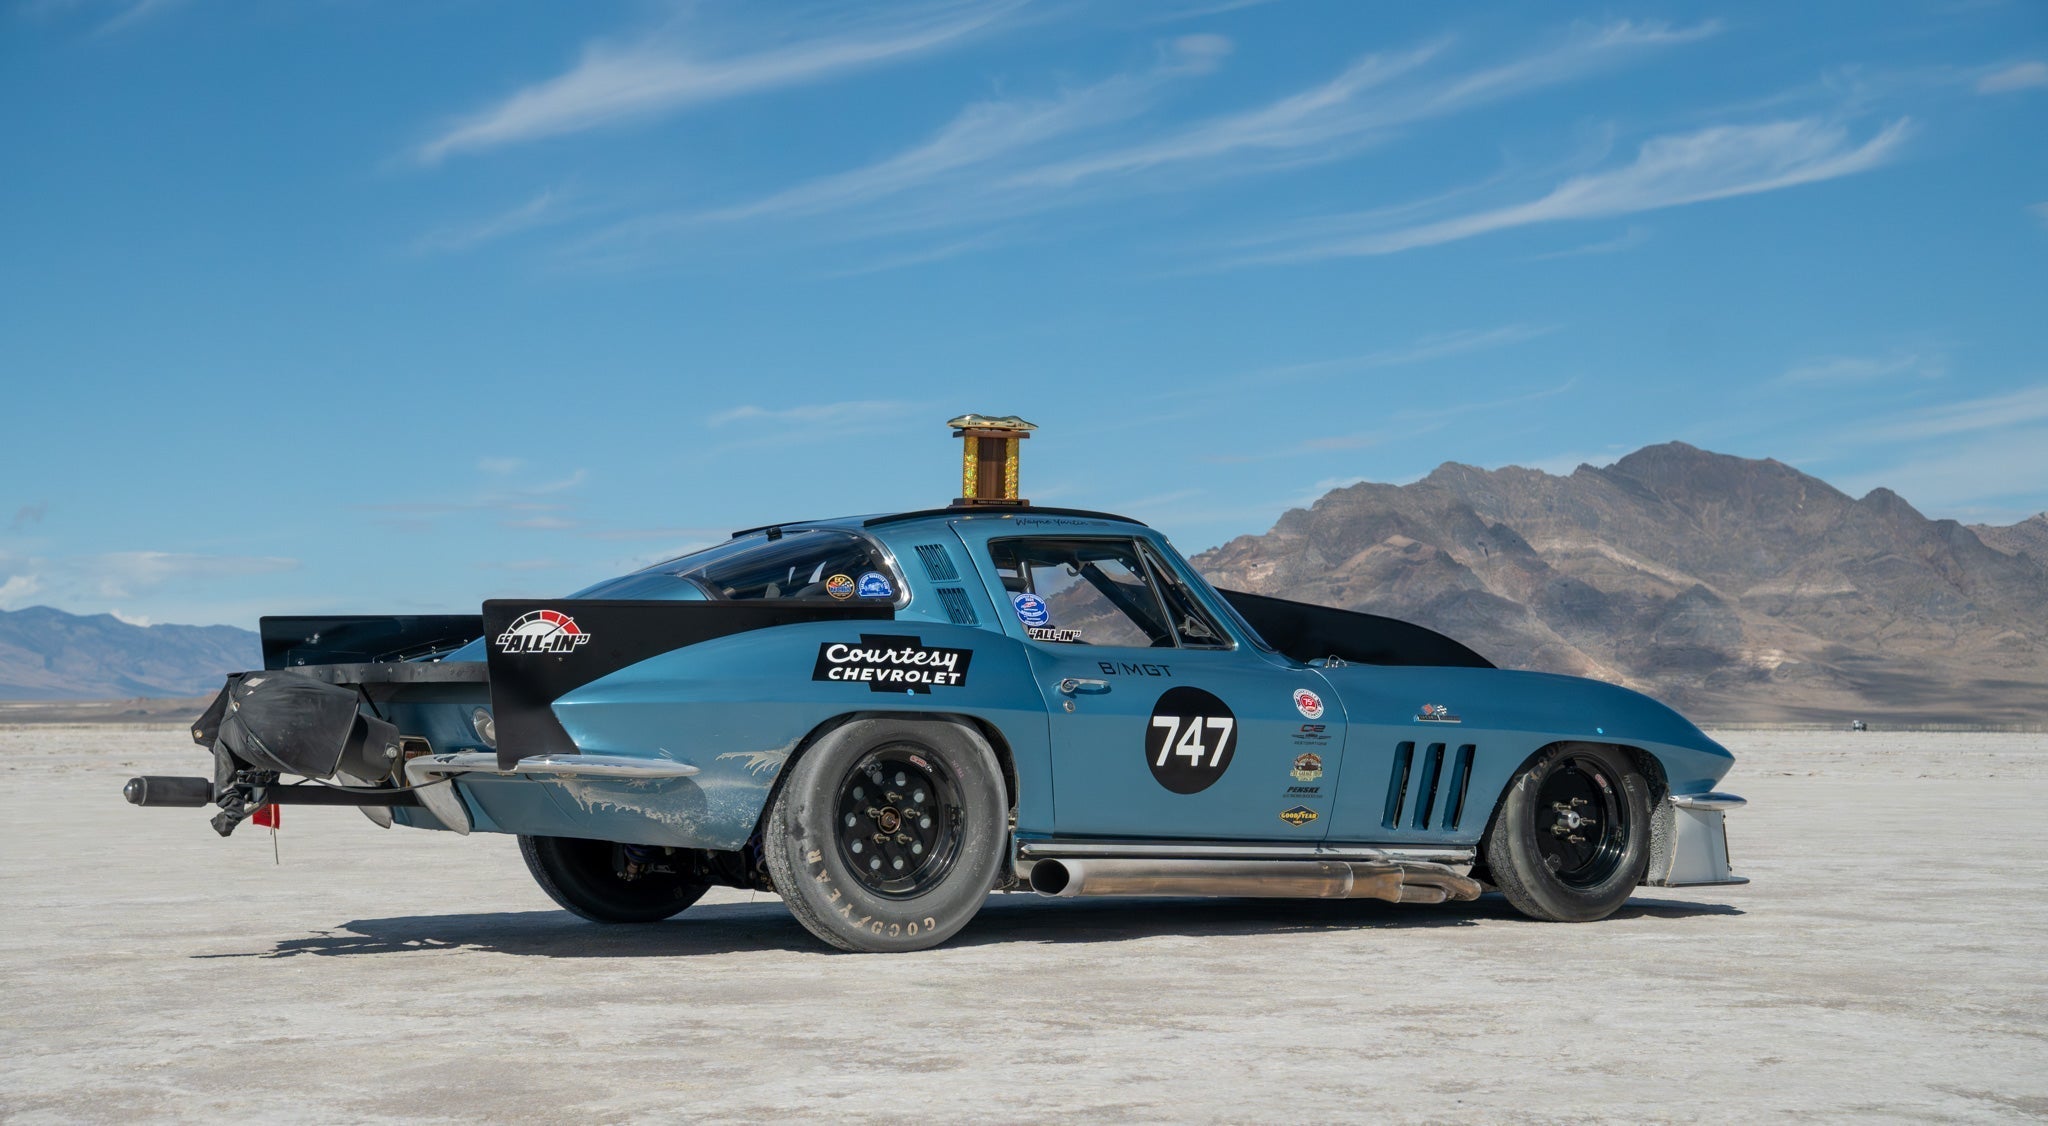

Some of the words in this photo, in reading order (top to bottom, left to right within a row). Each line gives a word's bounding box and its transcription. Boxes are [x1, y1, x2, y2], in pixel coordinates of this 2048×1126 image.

[1028, 628, 1081, 642] "ALL-IN"
[826, 643, 958, 671] Courtesy
[828, 667, 961, 685] CHEVROLET
[1097, 661, 1172, 677] B/MGT
[1152, 715, 1234, 767] 747
[1286, 786, 1321, 794] PENSKE
[1280, 811, 1317, 820] GOODYEAR
[806, 848, 936, 937] GOODYEAR
